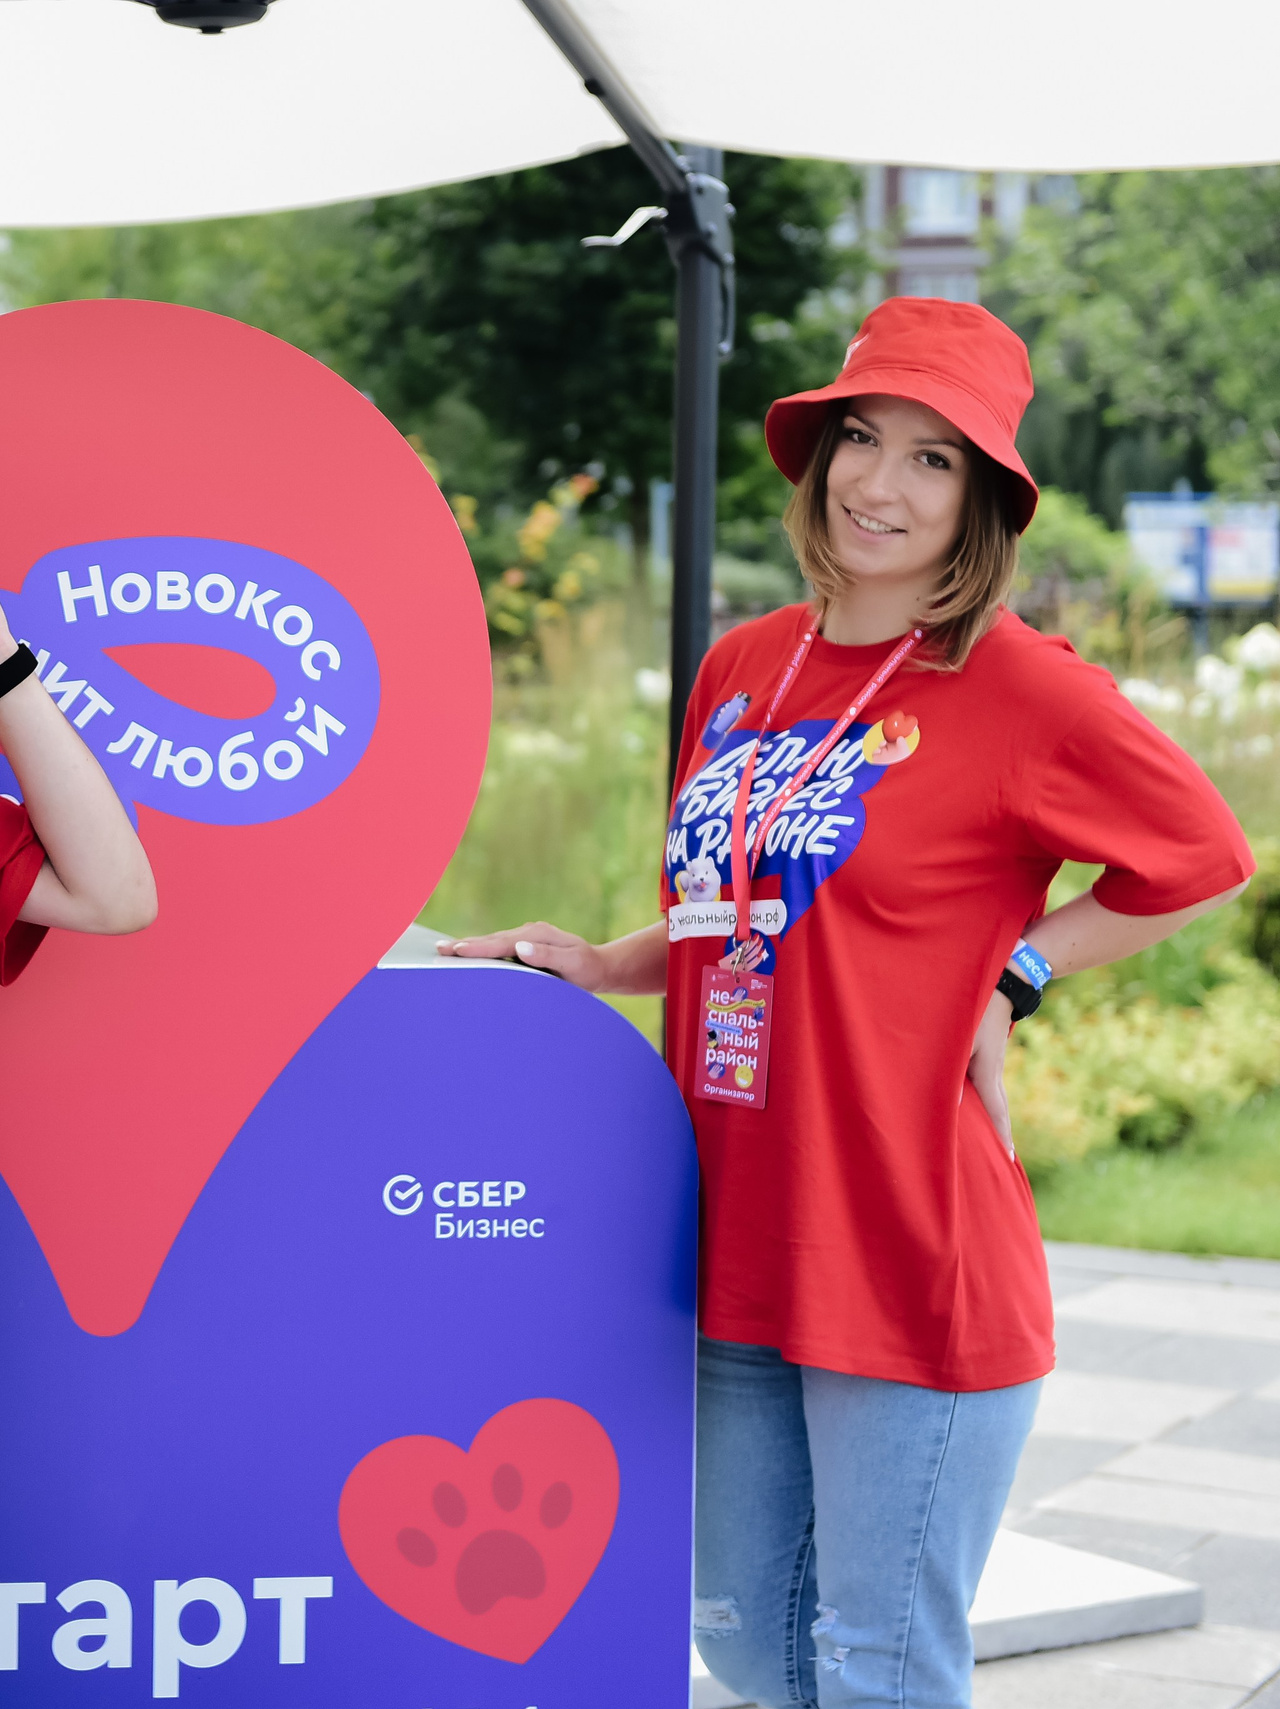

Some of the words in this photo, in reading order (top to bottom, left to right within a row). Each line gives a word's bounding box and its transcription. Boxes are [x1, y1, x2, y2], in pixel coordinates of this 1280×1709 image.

[56, 564, 342, 682] Новокос
[107, 696, 347, 791] любой
[724, 1032, 759, 1050] ный
[705, 1048, 758, 1070] район
[703, 1083, 755, 1101] Организатор
[432, 1181, 526, 1208] СБЕР
[435, 1212, 545, 1239] Бизнес
